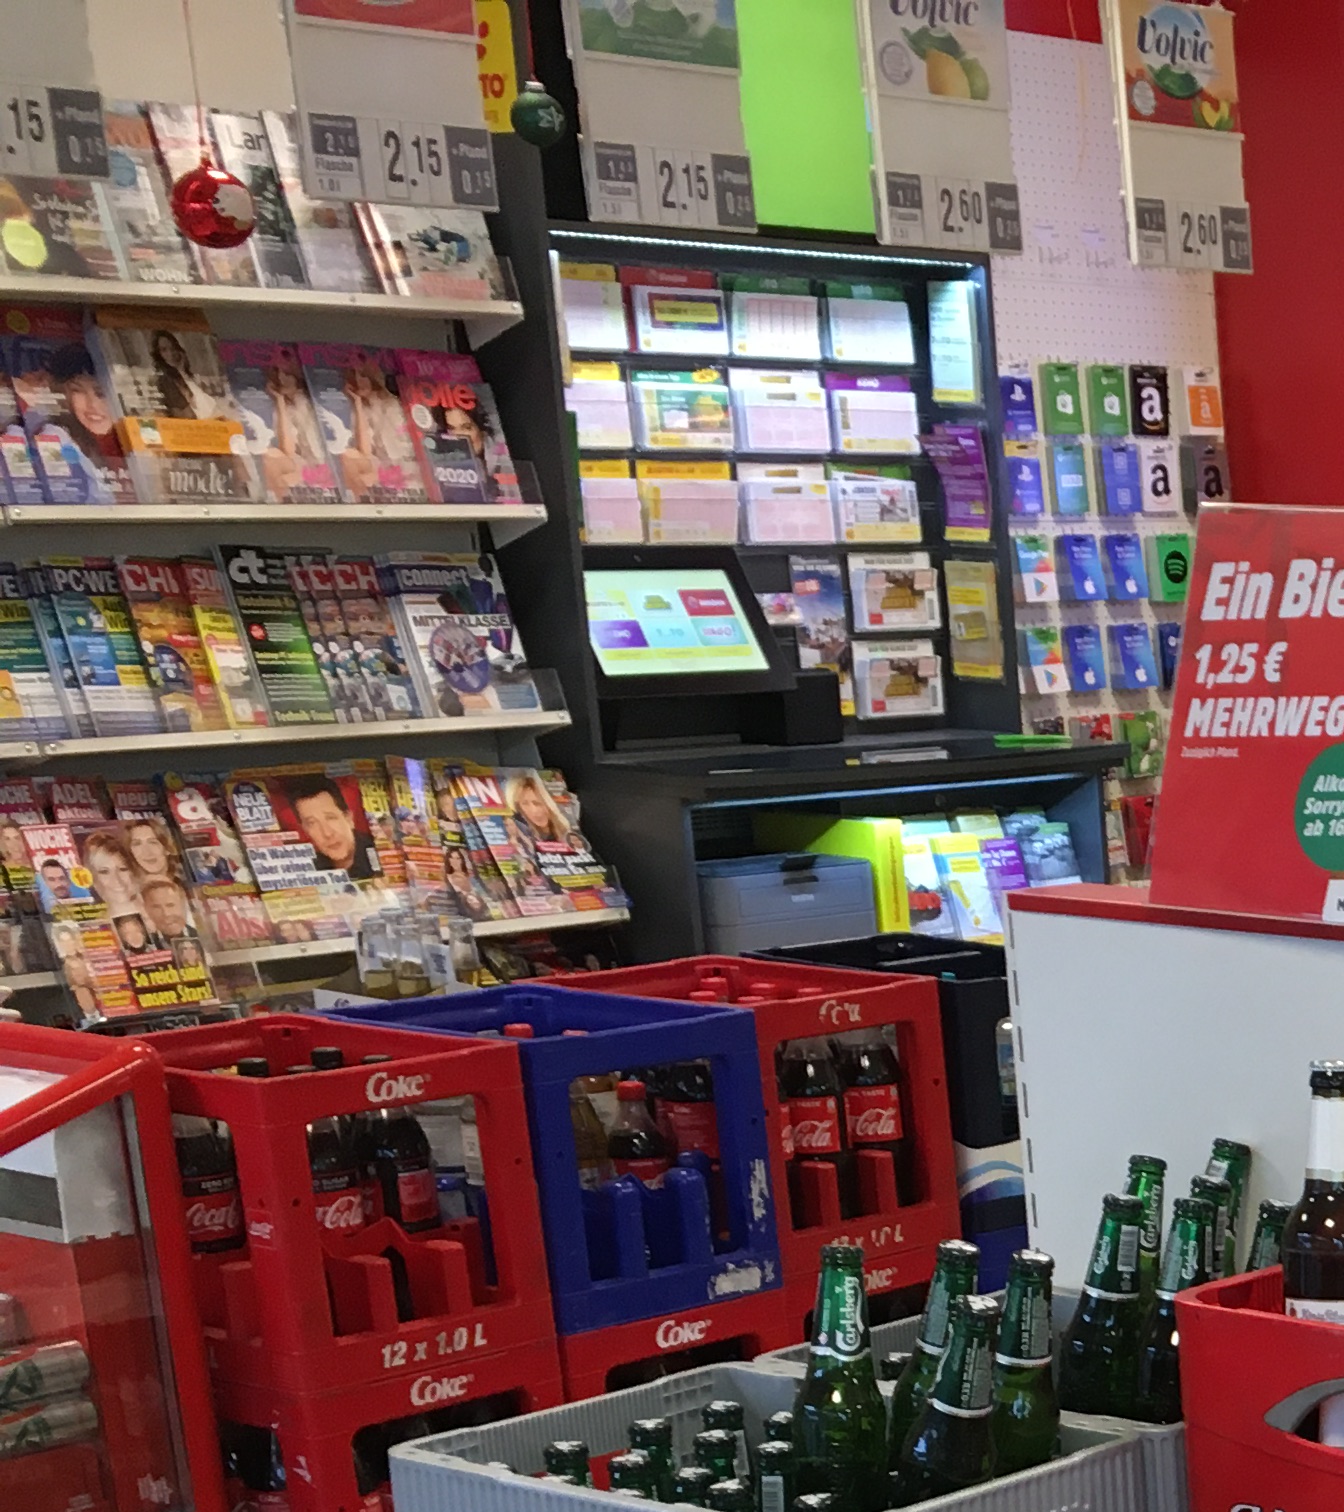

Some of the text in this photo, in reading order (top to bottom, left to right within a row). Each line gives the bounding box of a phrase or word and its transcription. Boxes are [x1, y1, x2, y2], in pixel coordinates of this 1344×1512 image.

[1137, 16, 1214, 65] Volvic
[384, 129, 442, 186] 2.15
[659, 160, 709, 211] 2.15
[940, 188, 982, 233] 2.60
[1181, 211, 1217, 254] 2.60
[434, 466, 478, 485] 2020
[401, 566, 469, 589] connect
[1200, 561, 1275, 622] Ein
[1194, 642, 1289, 690] 1,25 €
[53, 783, 97, 805] ADEL
[232, 790, 268, 808] NEUE
[237, 804, 274, 824] BLATT
[1303, 818, 1323, 837] ab
[23, 830, 73, 850] WOCHE
[250, 844, 317, 862] Die Wahrheit
[254, 859, 313, 877] über seinen
[329, 869, 349, 885] Tod
[132, 969, 149, 989] So
[150, 966, 179, 986] reich
[138, 983, 214, 1009] unsere Stars!
[365, 1071, 426, 1103] Coke
[856, 1107, 896, 1136] Cola
[1139, 1181, 1161, 1252] Carlsberg
[864, 1269, 893, 1292] oke
[836, 1276, 860, 1352] Carlsberg
[382, 1324, 487, 1368] 12 x 1.0 L
[656, 1320, 708, 1350] Coke
[410, 1375, 470, 1406] Coke
